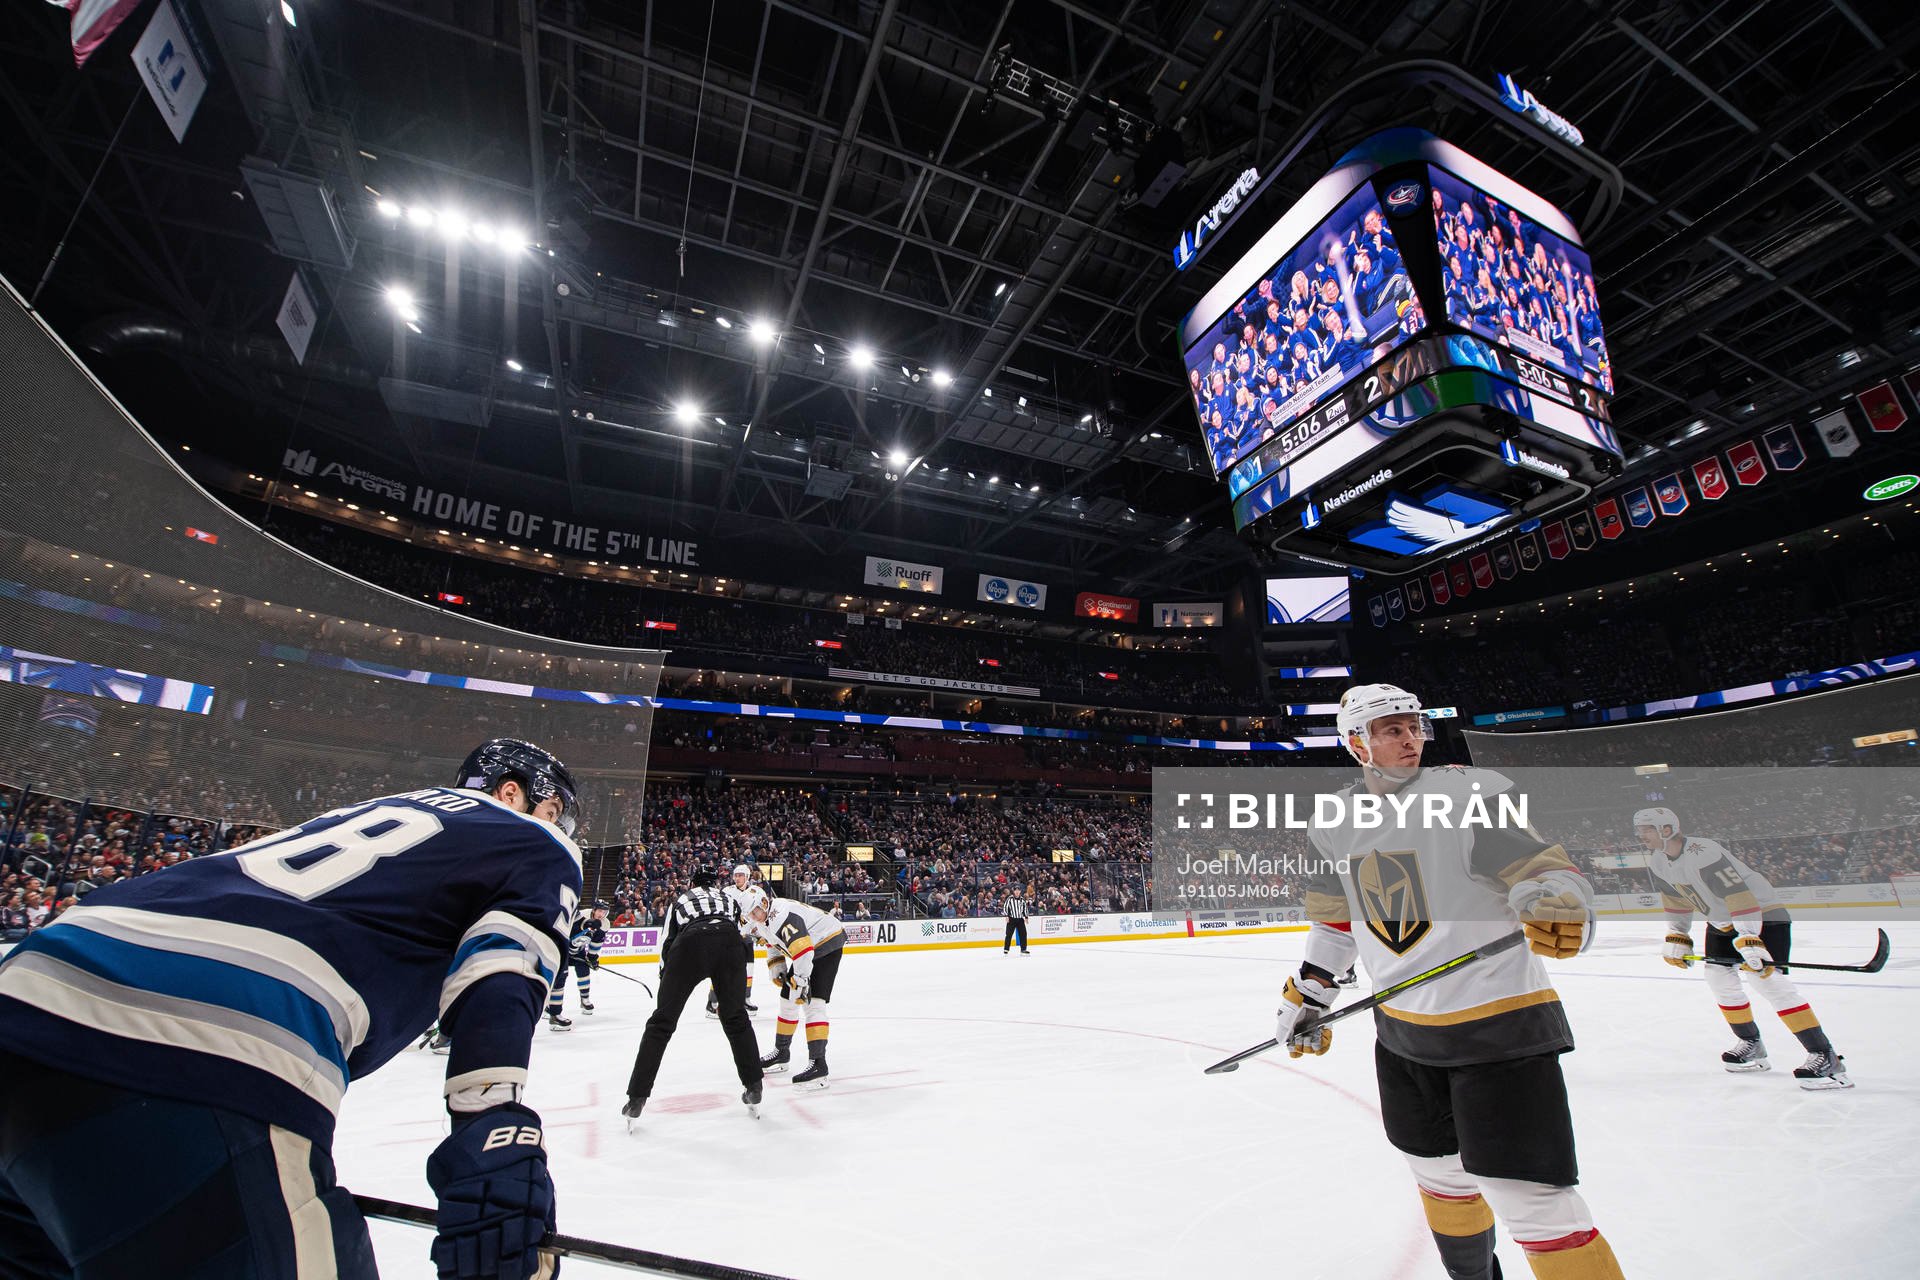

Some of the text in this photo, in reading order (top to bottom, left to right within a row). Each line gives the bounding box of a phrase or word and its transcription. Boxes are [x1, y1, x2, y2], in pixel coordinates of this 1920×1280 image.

[1517, 360, 1552, 388] 5:06
[1293, 386, 1315, 402] National
[1314, 374, 1330, 388] Team
[1364, 375, 1383, 404] 2
[1579, 388, 1595, 412] 2
[1281, 415, 1321, 453] 5:06
[1253, 455, 1263, 476] 1
[319, 462, 407, 502] Arena
[345, 464, 408, 491] Nationwide
[1323, 469, 1394, 513] Nationwide
[412, 485, 501, 532] HOME
[506, 510, 544, 540] OF
[552, 520, 600, 552] THE
[606, 530, 641, 556] 5TH
[895, 566, 932, 582] Ruoff
[987, 580, 1009, 599] Kroger
[1018, 585, 1038, 604] Kroger
[1096, 606, 1116, 615] Office
[1097, 599, 1132, 610] Continental
[873, 674, 1005, 692] LET'S GO JACKETS
[1507, 711, 1545, 719] OhioHealth
[1714, 865, 1742, 889] 15
[780, 923, 799, 943] 71
[876, 923, 897, 943] AD
[936, 922, 968, 933] Ruoff
[1134, 919, 1178, 928] OhioHealth
